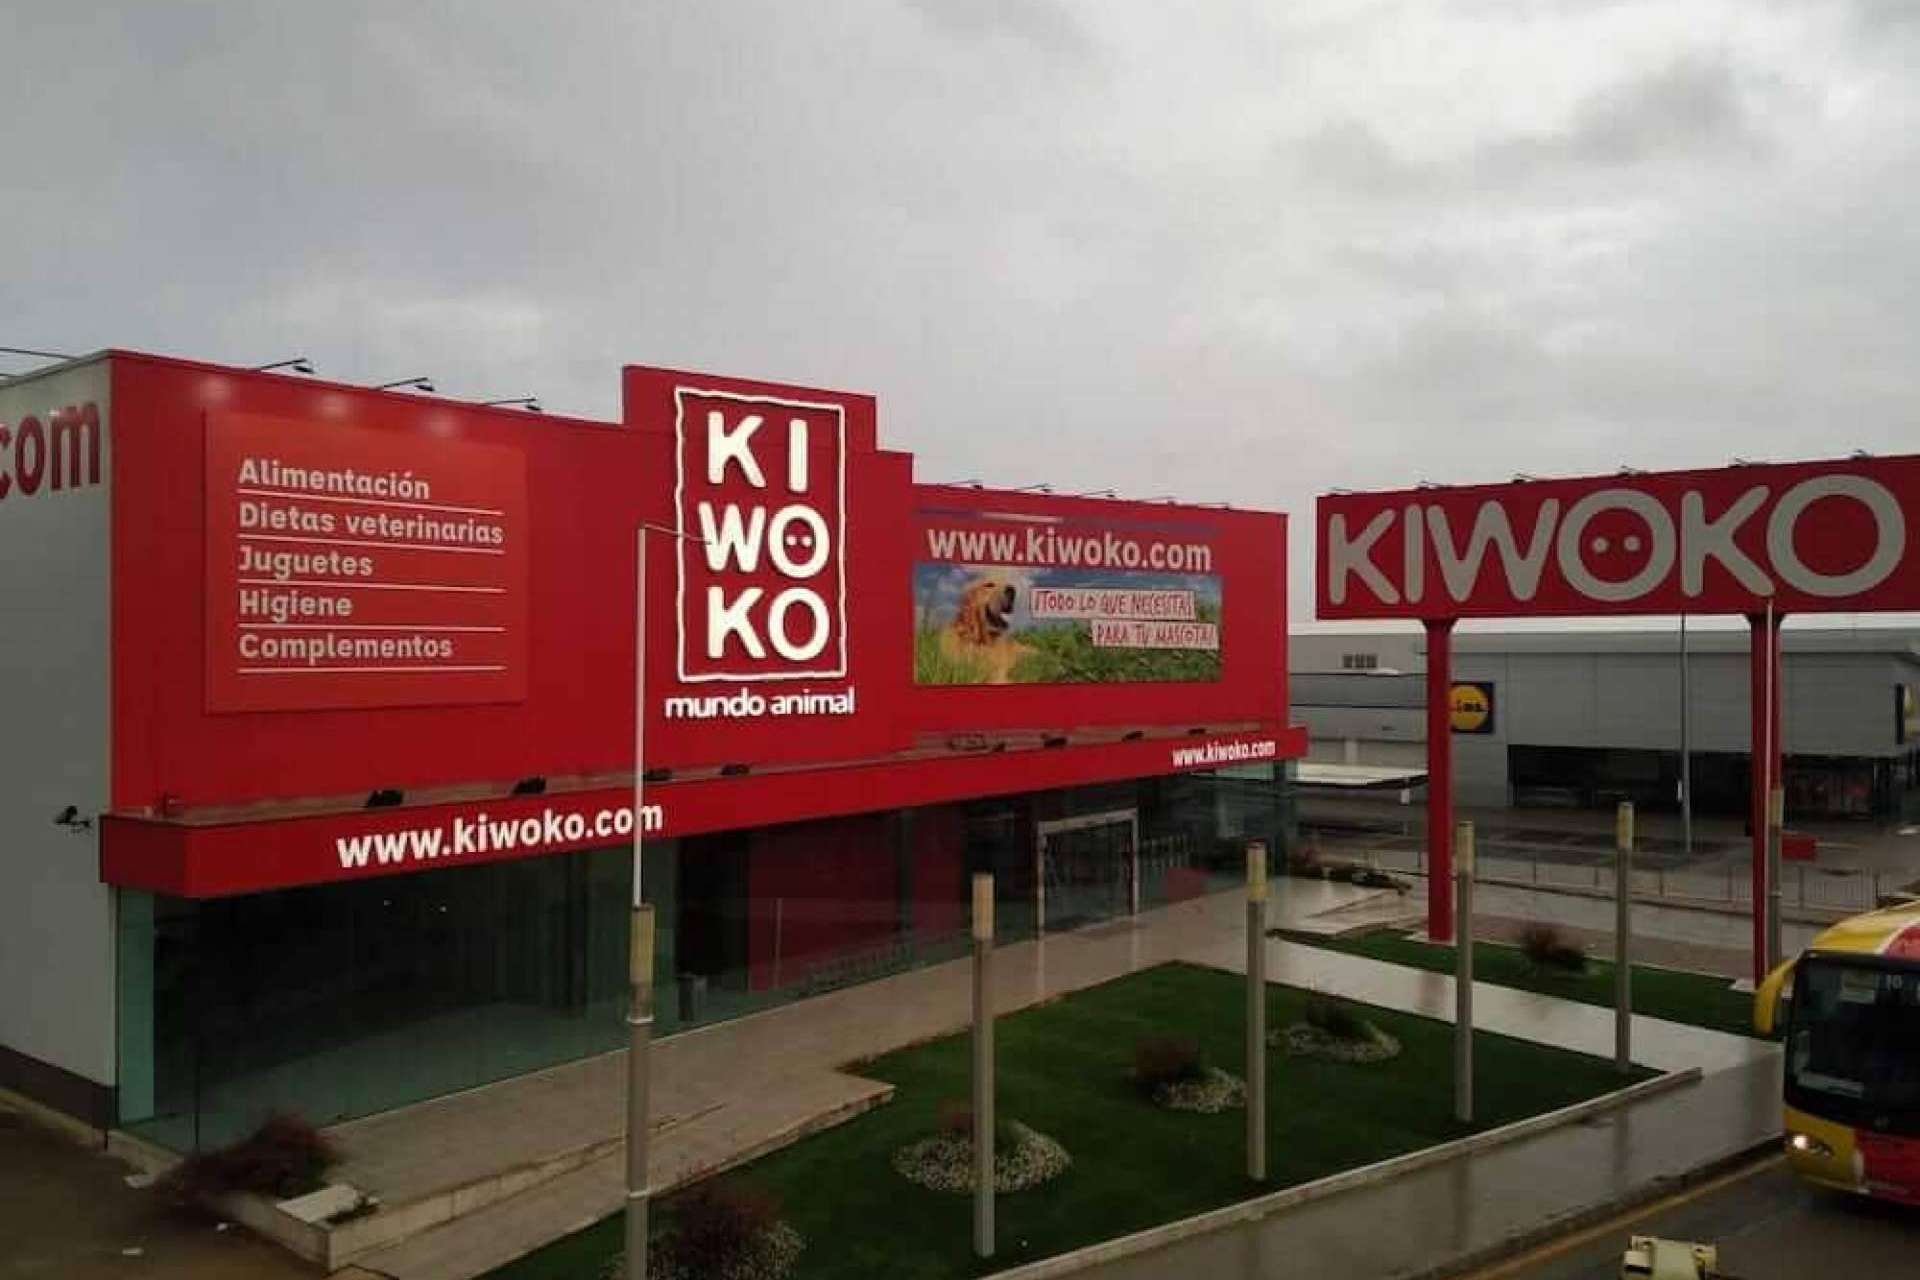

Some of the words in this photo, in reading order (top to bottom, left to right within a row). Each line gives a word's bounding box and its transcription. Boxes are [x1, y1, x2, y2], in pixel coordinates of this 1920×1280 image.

[238, 458, 430, 500] Alimentación
[239, 501, 336, 533] Dietas
[345, 508, 504, 545] veterinarias
[1328, 474, 1906, 605] KIWOKO
[238, 545, 373, 580] Juguetes
[927, 527, 1212, 571] www.kiwoko.com
[239, 590, 352, 622] Higiene
[1102, 593, 1126, 614] QUE
[239, 633, 453, 665] Complementos
[1097, 624, 1128, 642] PARA
[665, 687, 765, 718] mundo
[770, 686, 855, 715] animal
[1172, 739, 1276, 768] www.kiwoko.com
[336, 804, 663, 868] www.kiwoko.com
